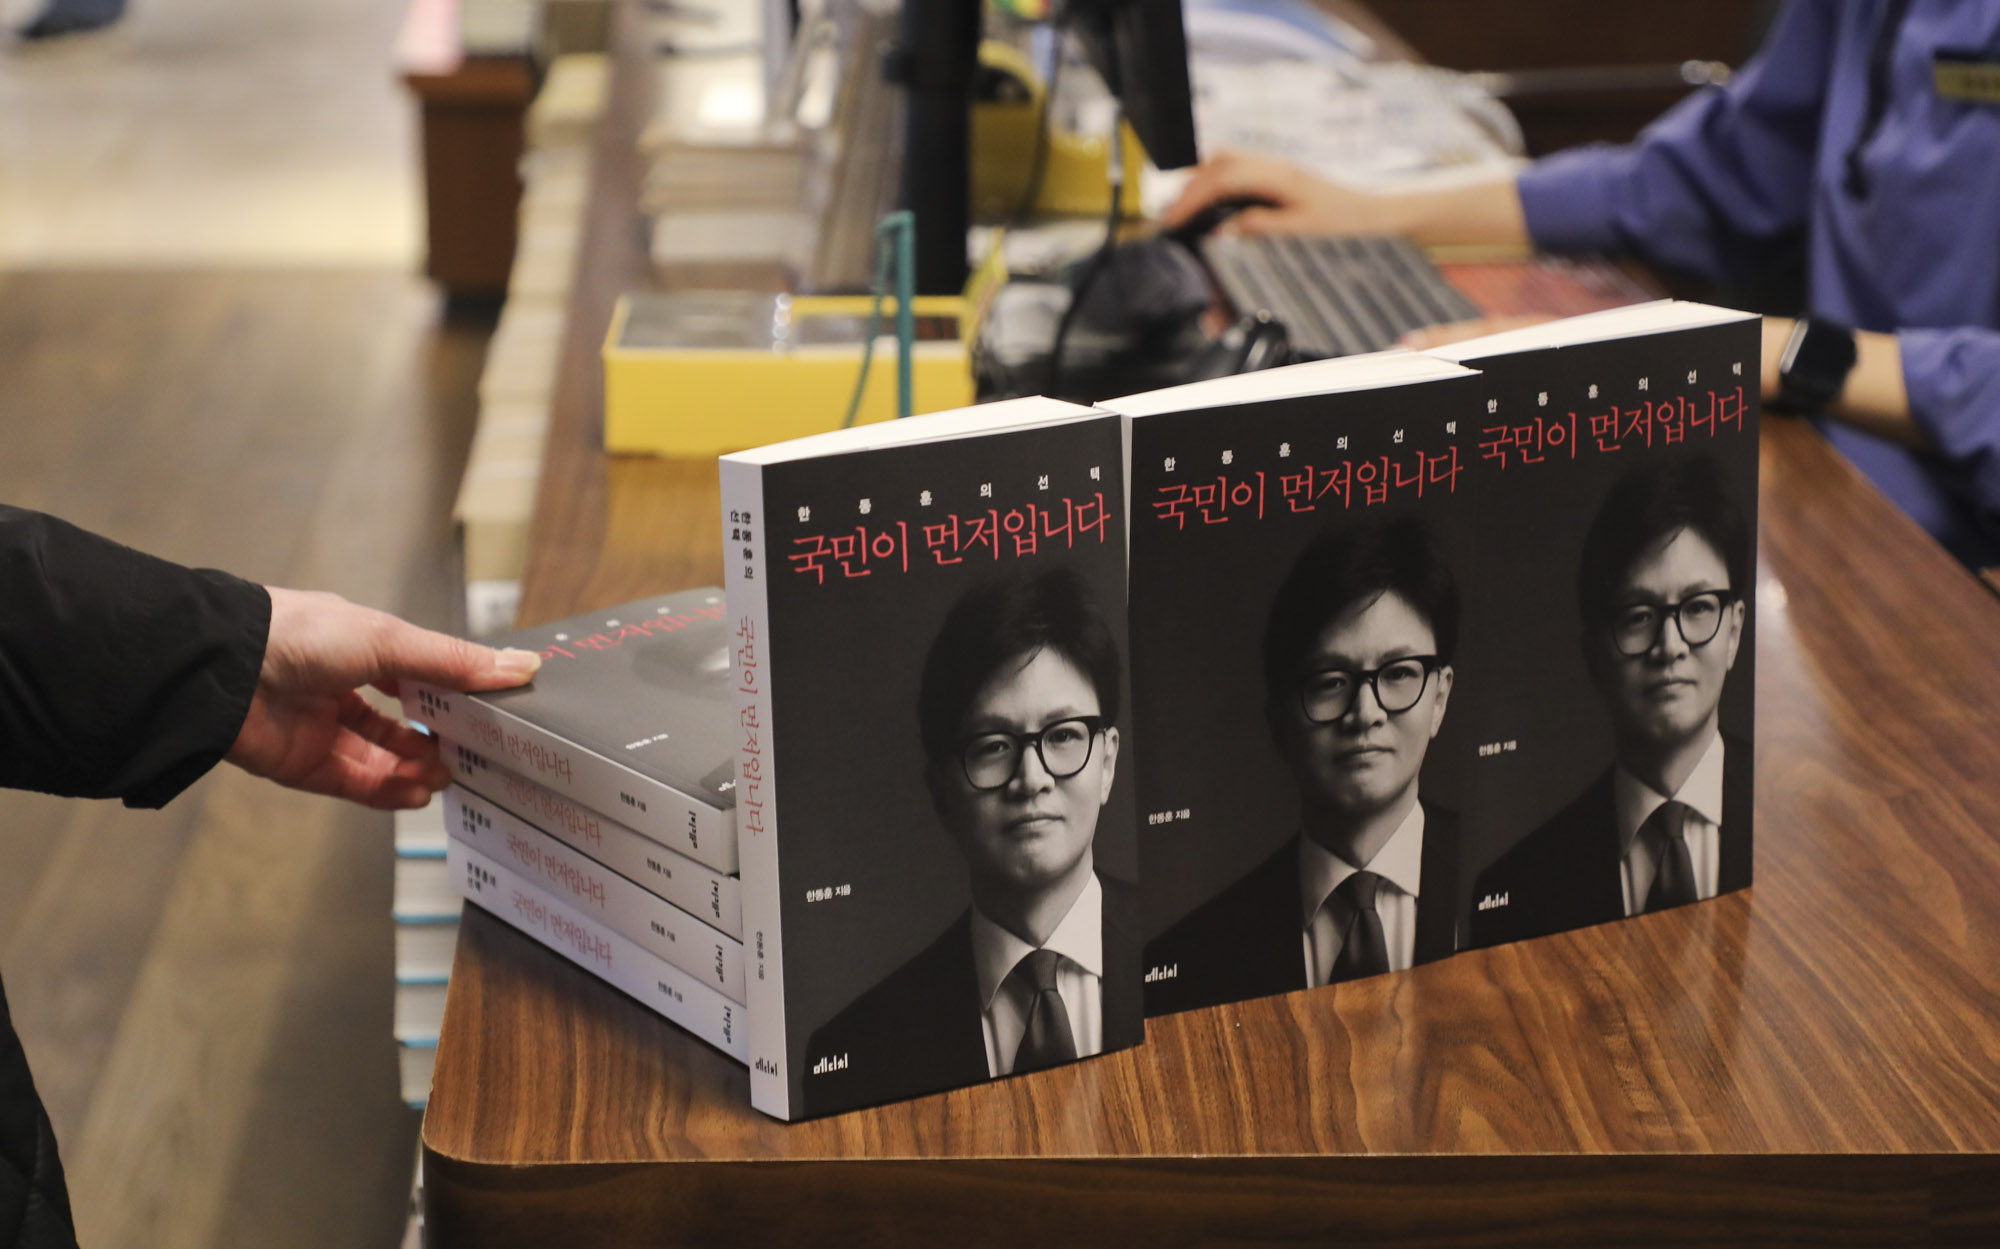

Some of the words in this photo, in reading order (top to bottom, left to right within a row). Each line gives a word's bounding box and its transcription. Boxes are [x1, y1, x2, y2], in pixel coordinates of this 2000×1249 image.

[1687, 361, 1742, 385] 선택
[1163, 435, 1349, 472] 한동훈의
[1392, 420, 1457, 443] 선택
[1478, 412, 1577, 470] 국민이
[1589, 385, 1749, 452] 먼저입니다
[797, 482, 993, 522] 한동훈의
[1037, 465, 1100, 491] 선택
[1151, 470, 1266, 530] 국민이
[1279, 445, 1464, 514] 먼저입니다
[787, 520, 909, 585] 국민이
[922, 492, 1112, 566] 먼저입니다
[736, 615, 758, 694] 국민이
[506, 734, 573, 785] 먼저입니다
[740, 704, 765, 837] 먼저입니다
[1148, 810, 1173, 826] 한동훈
[544, 855, 606, 909] 먼저입니다
[806, 886, 833, 903] 한동훈
[835, 883, 851, 897] 지음
[550, 913, 613, 969] 먼저입니다
